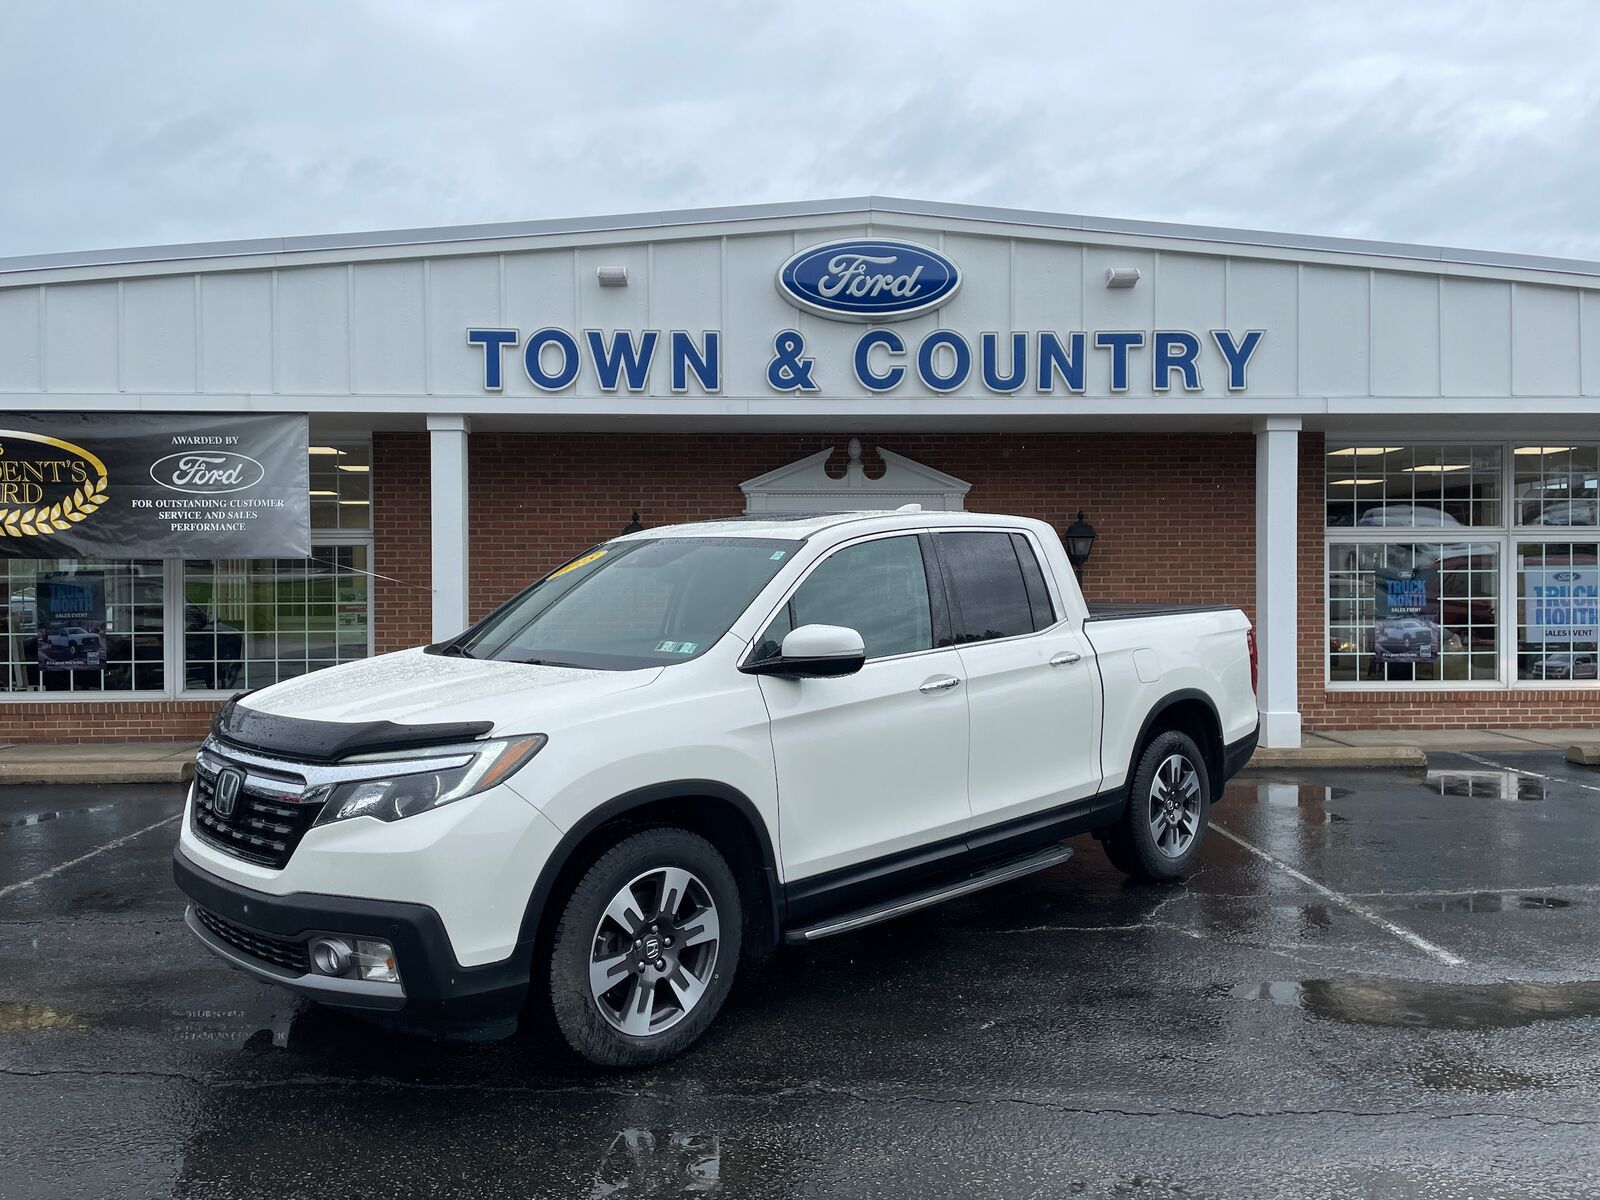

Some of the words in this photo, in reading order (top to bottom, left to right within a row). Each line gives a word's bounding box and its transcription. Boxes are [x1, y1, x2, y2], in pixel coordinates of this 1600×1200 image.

[817, 253, 924, 298] Ford
[466, 327, 721, 393] TOWN
[765, 328, 821, 393] &
[852, 327, 1267, 393] COUNTRY
[171, 436, 223, 446] AWARDED
[225, 436, 240, 446] BY
[0, 460, 87, 483] ENT'S
[172, 456, 244, 485] Ford
[131, 499, 153, 508] FOR
[155, 499, 227, 508] OUTSTANDING
[229, 498, 285, 508] CUSTOMER
[158, 511, 202, 520] SERVICE
[204, 511, 226, 520] AND
[227, 511, 258, 520] SALES
[170, 522, 247, 532] PERFORMANCE
[1386, 580, 1427, 594] TRUCK
[1387, 594, 1427, 607] MONTH
[1533, 586, 1598, 607] TRUCK
[50, 599, 94, 612] MONTH
